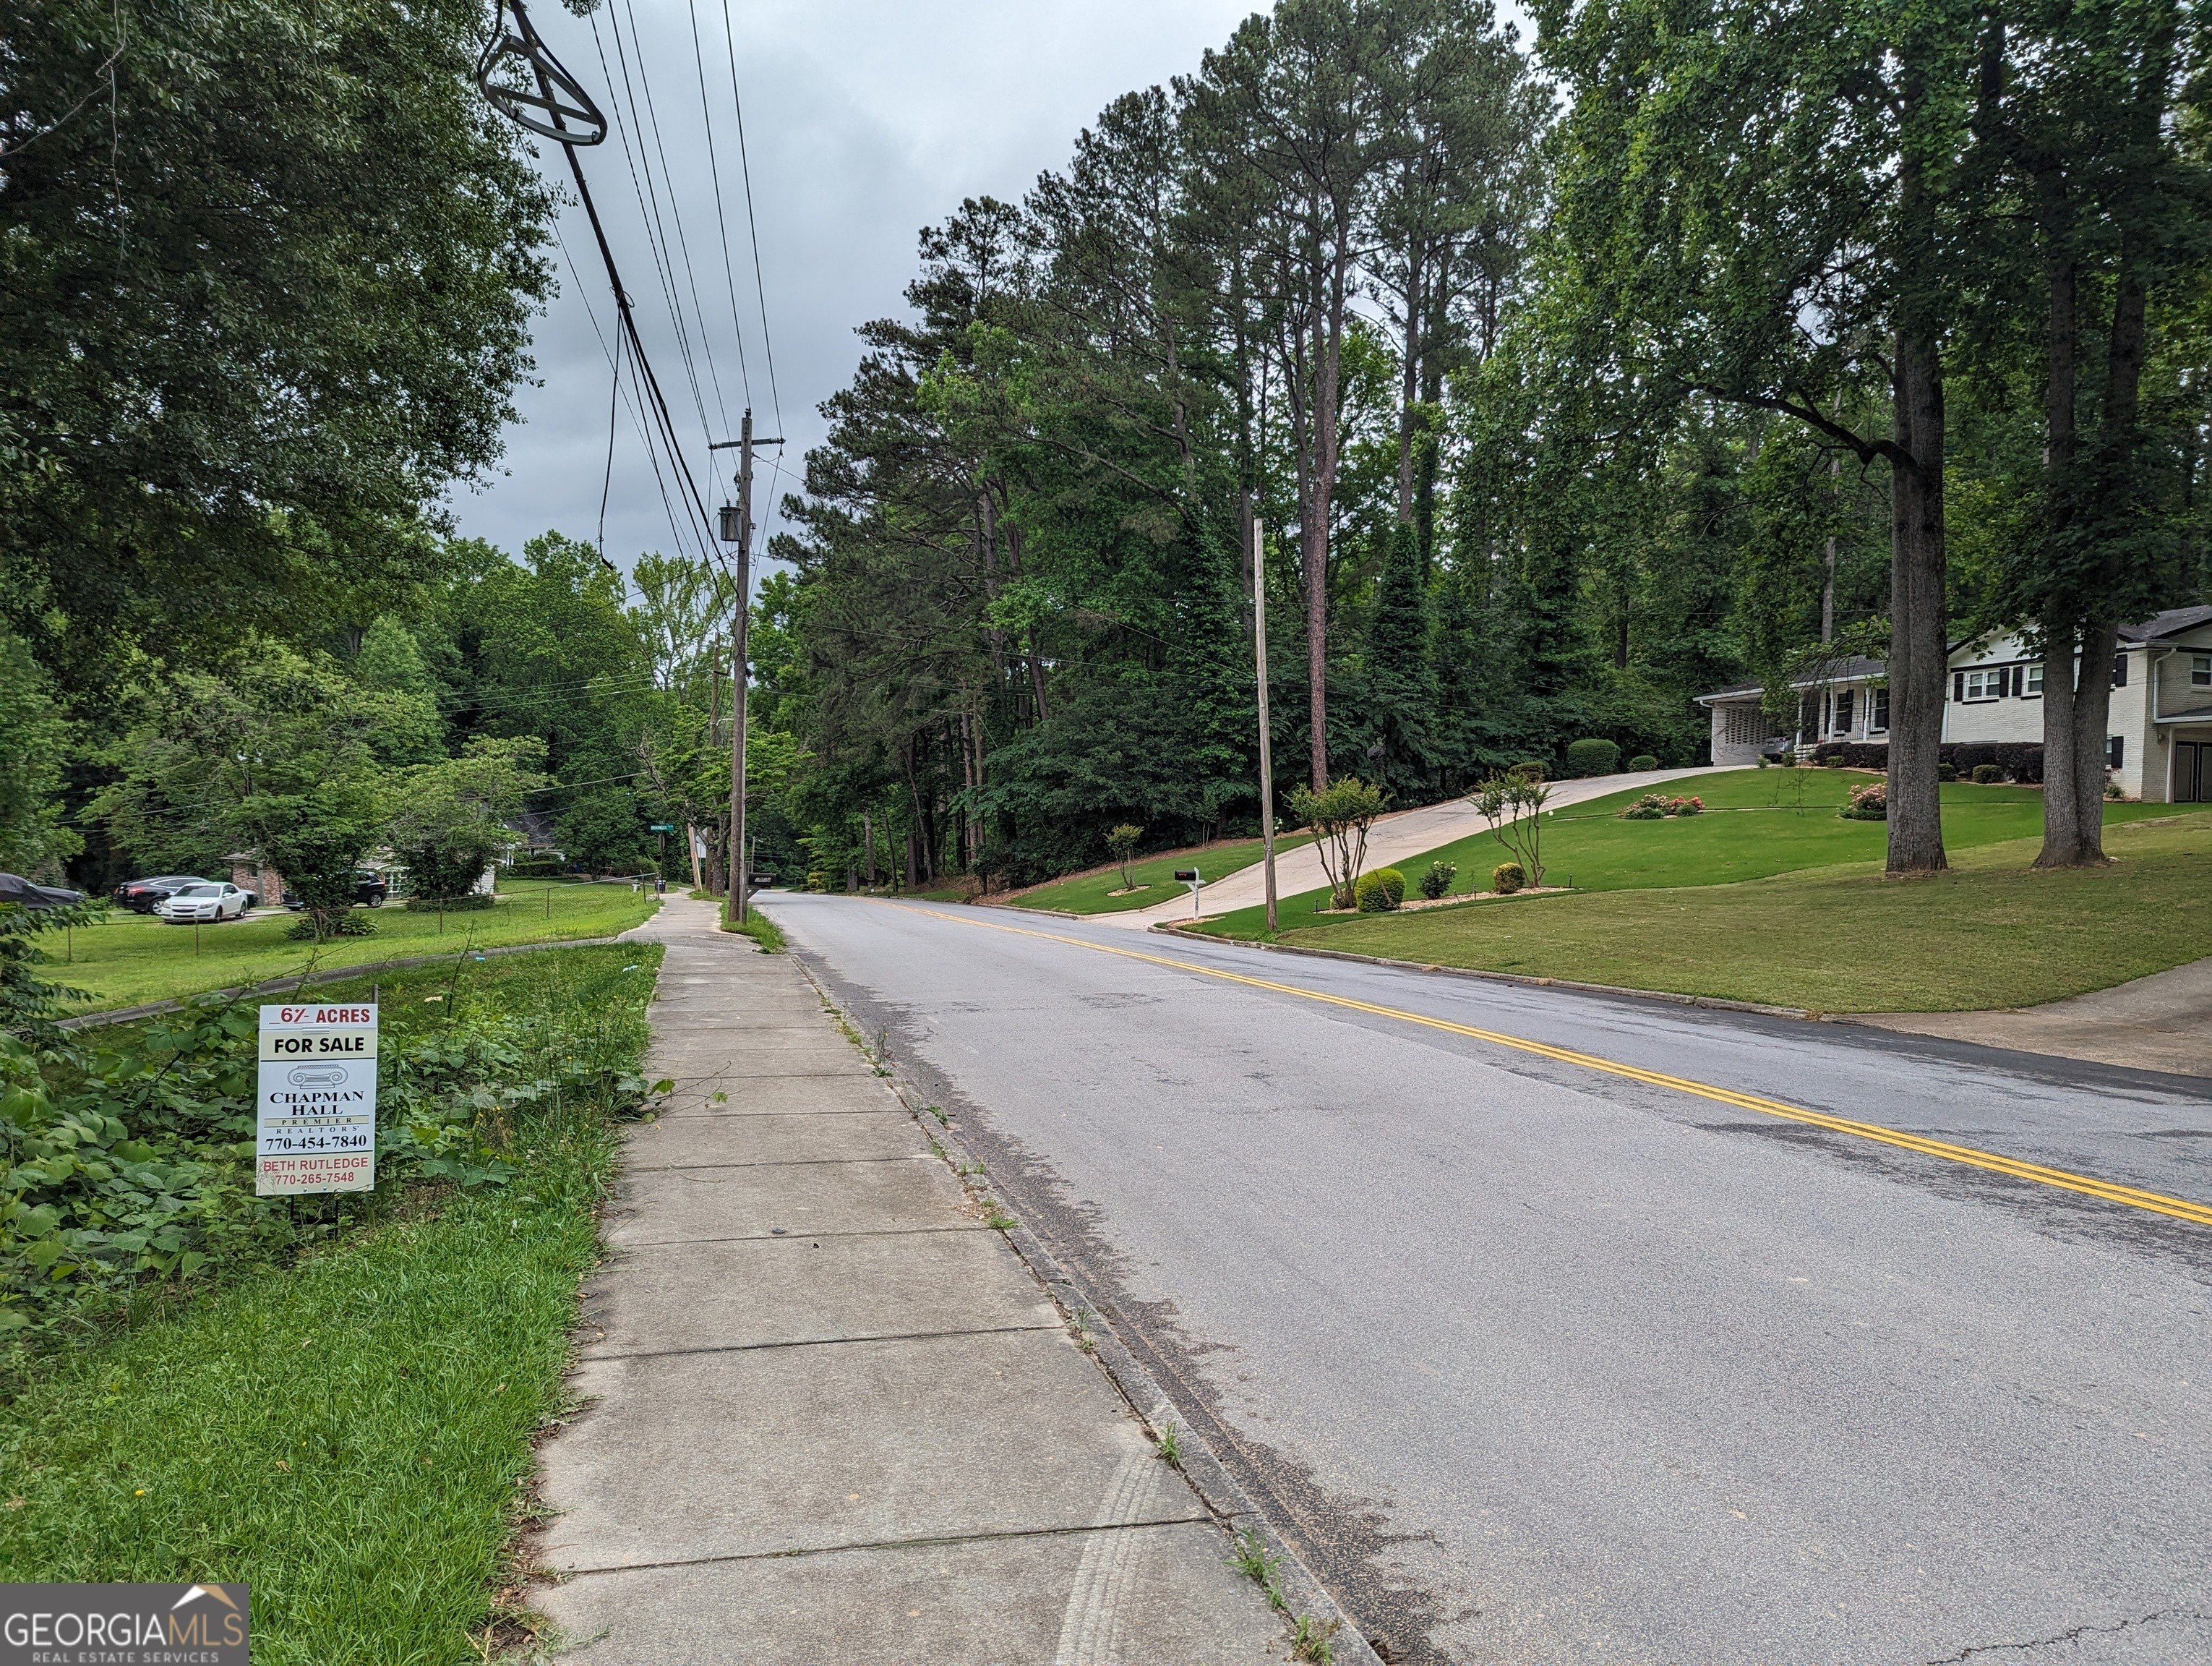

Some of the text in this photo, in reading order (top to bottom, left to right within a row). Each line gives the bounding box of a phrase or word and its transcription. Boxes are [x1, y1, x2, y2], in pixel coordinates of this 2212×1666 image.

[315, 1009, 370, 1023] ACRES
[274, 1037, 364, 1054] FOR SALE
[270, 1090, 364, 1103] CHAPMAN
[291, 1104, 343, 1116] HALL
[281, 1117, 352, 1126] PREMIER
[265, 1135, 367, 1150] 770-454-7840
[263, 1157, 369, 1172] BETH RUTLEDGE
[275, 1171, 355, 1185] 770-265-7548
